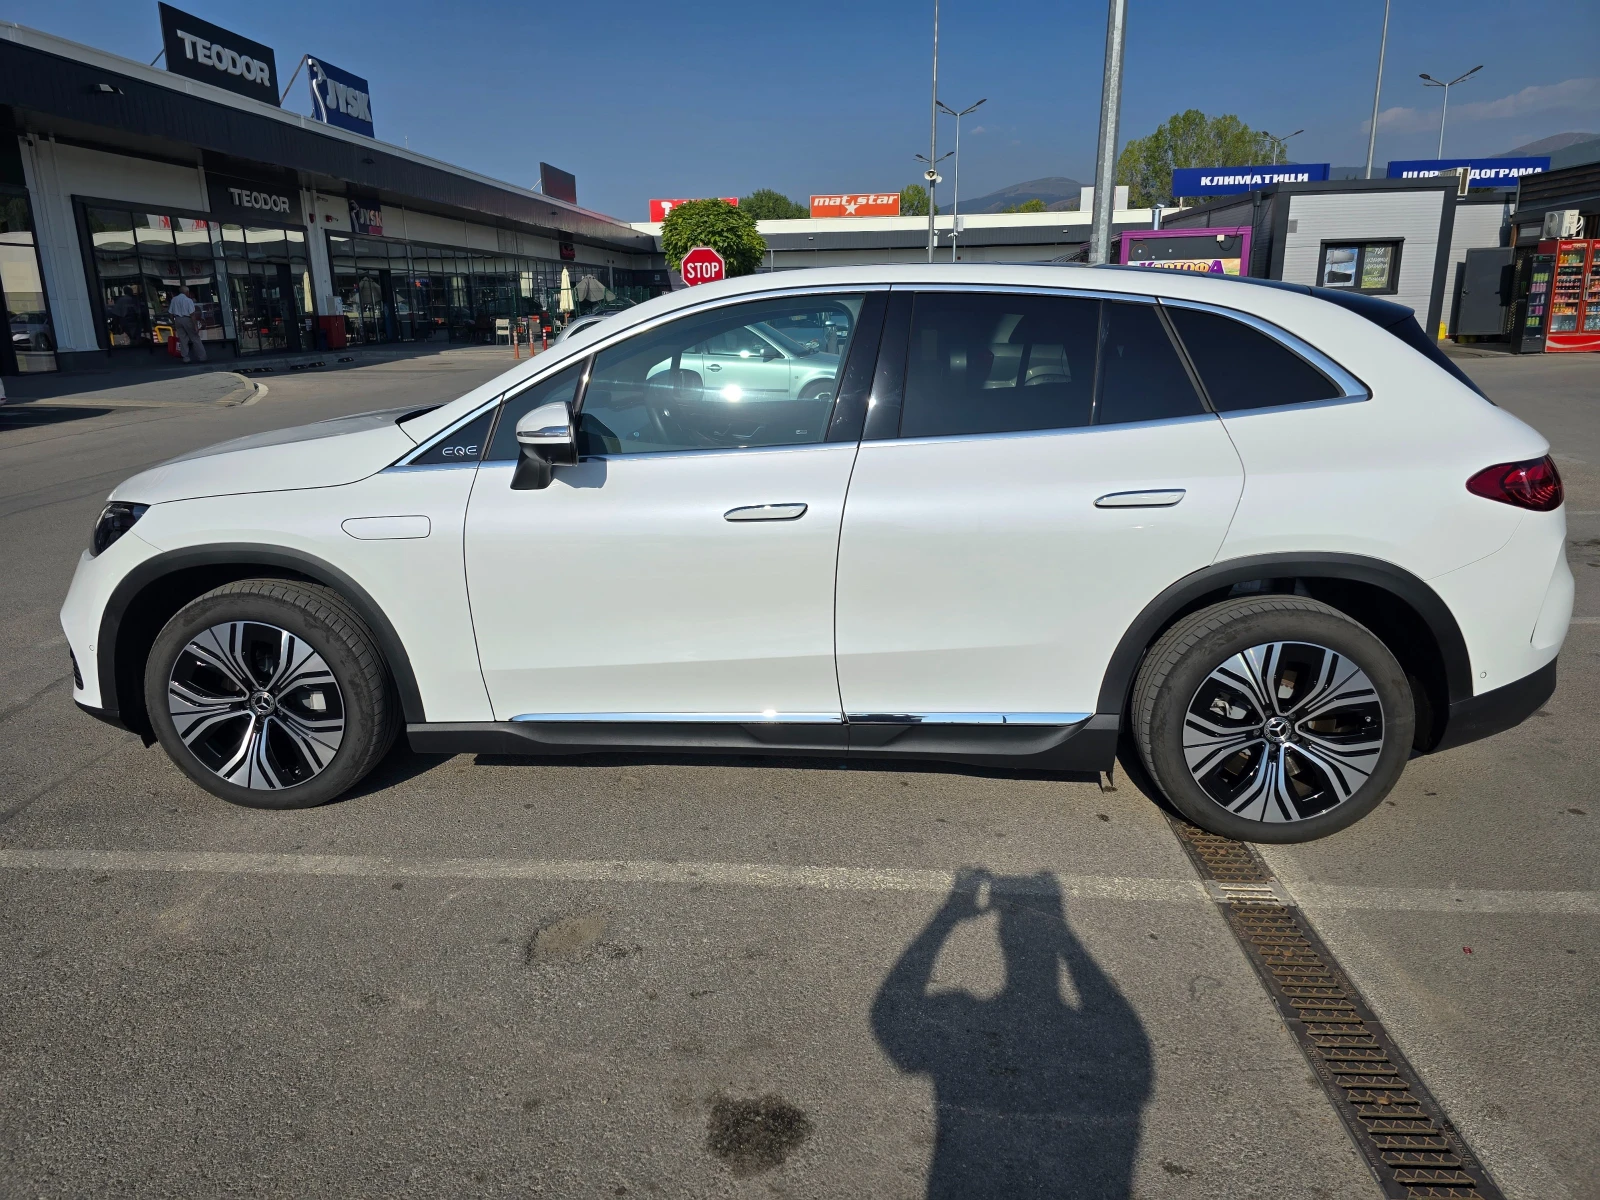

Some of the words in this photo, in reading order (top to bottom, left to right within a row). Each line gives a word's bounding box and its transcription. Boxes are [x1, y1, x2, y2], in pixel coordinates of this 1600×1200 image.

[176, 29, 270, 87] TEODOR
[326, 79, 372, 122] JYSK
[1201, 173, 1309, 186] КЛИМАТИЦИ
[1469, 167, 1542, 179] ДОГРАМА
[228, 187, 290, 214] TEODOR
[813, 196, 851, 206] mat
[856, 195, 898, 205] star
[359, 208, 383, 227] JYSK
[687, 262, 719, 278] STOP
[442, 445, 478, 457] EQE
